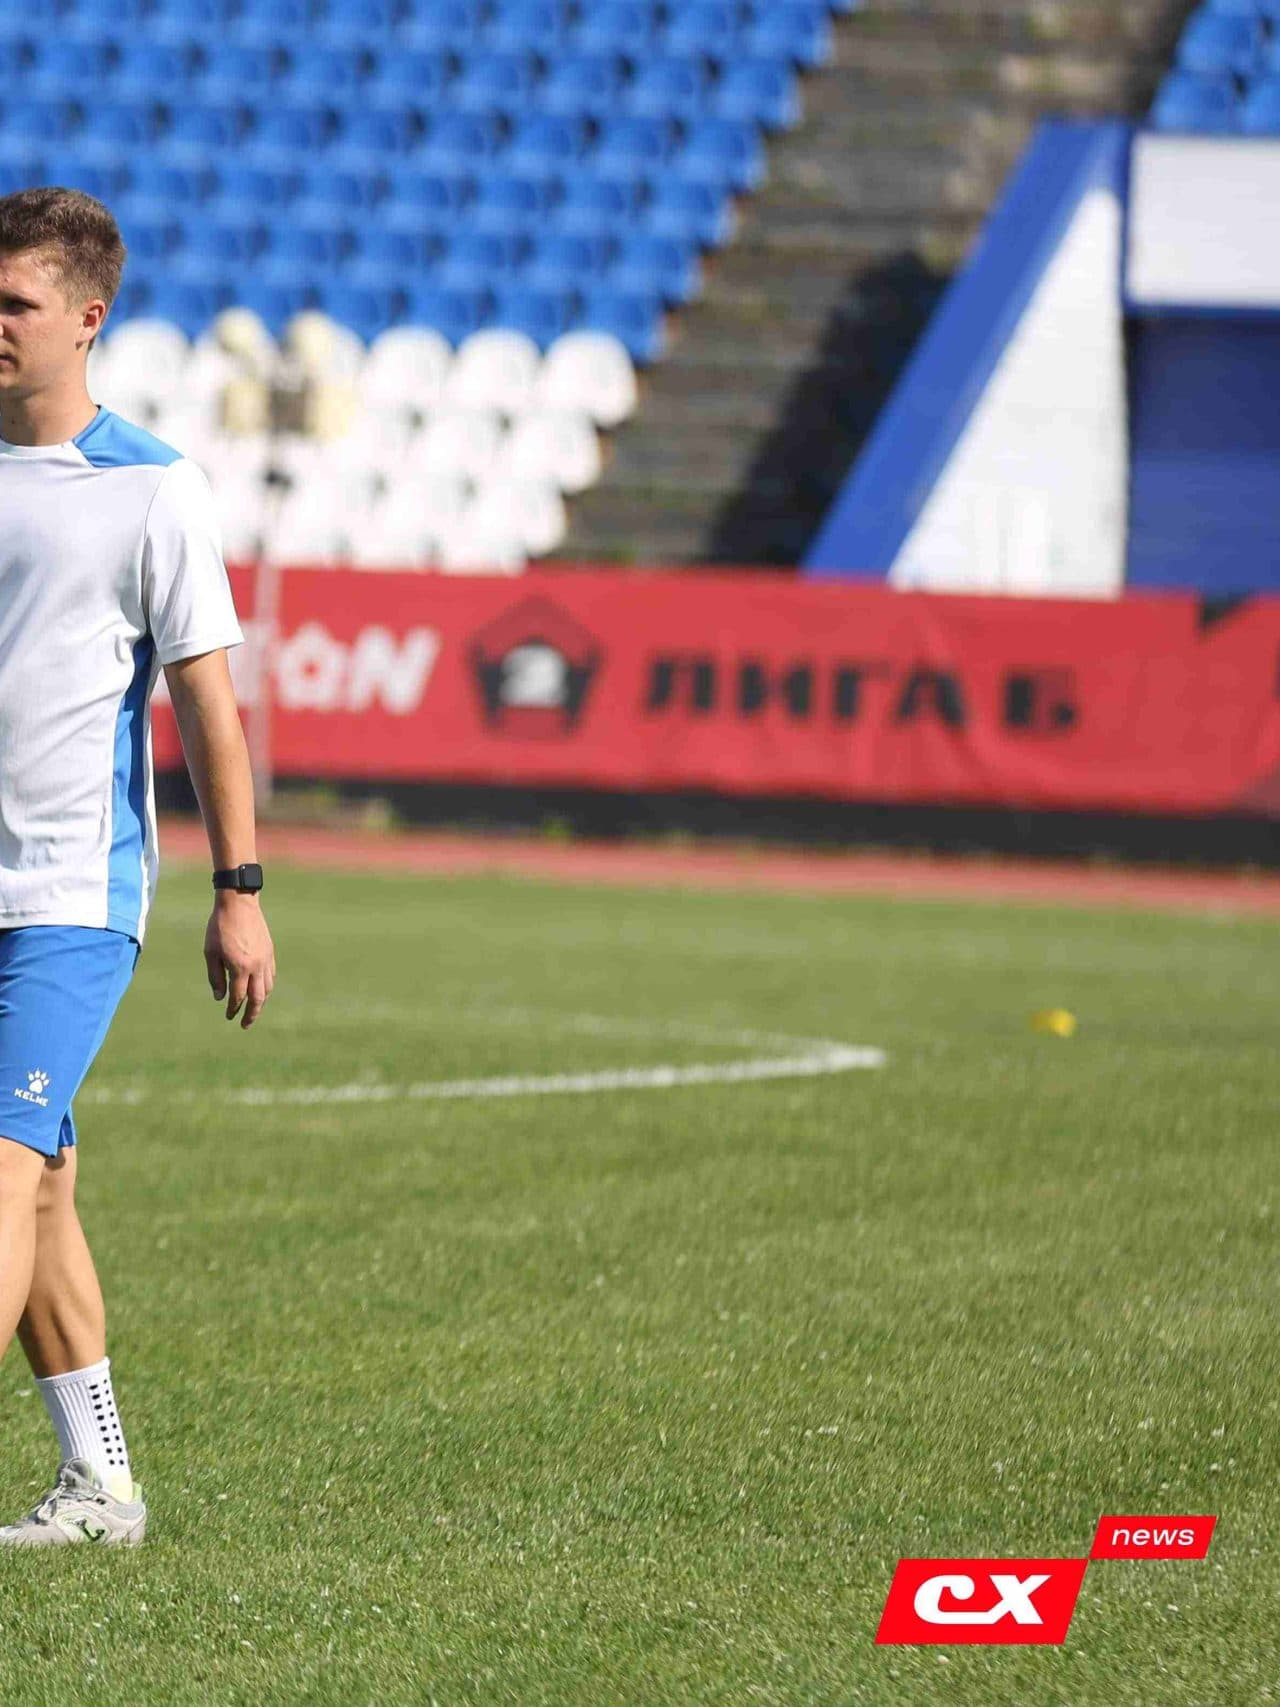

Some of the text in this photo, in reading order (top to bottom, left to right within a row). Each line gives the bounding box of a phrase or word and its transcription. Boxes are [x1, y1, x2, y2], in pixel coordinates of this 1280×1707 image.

[641, 648, 1080, 740] ЛИГА Б
[13, 1087, 49, 1107] KELME
